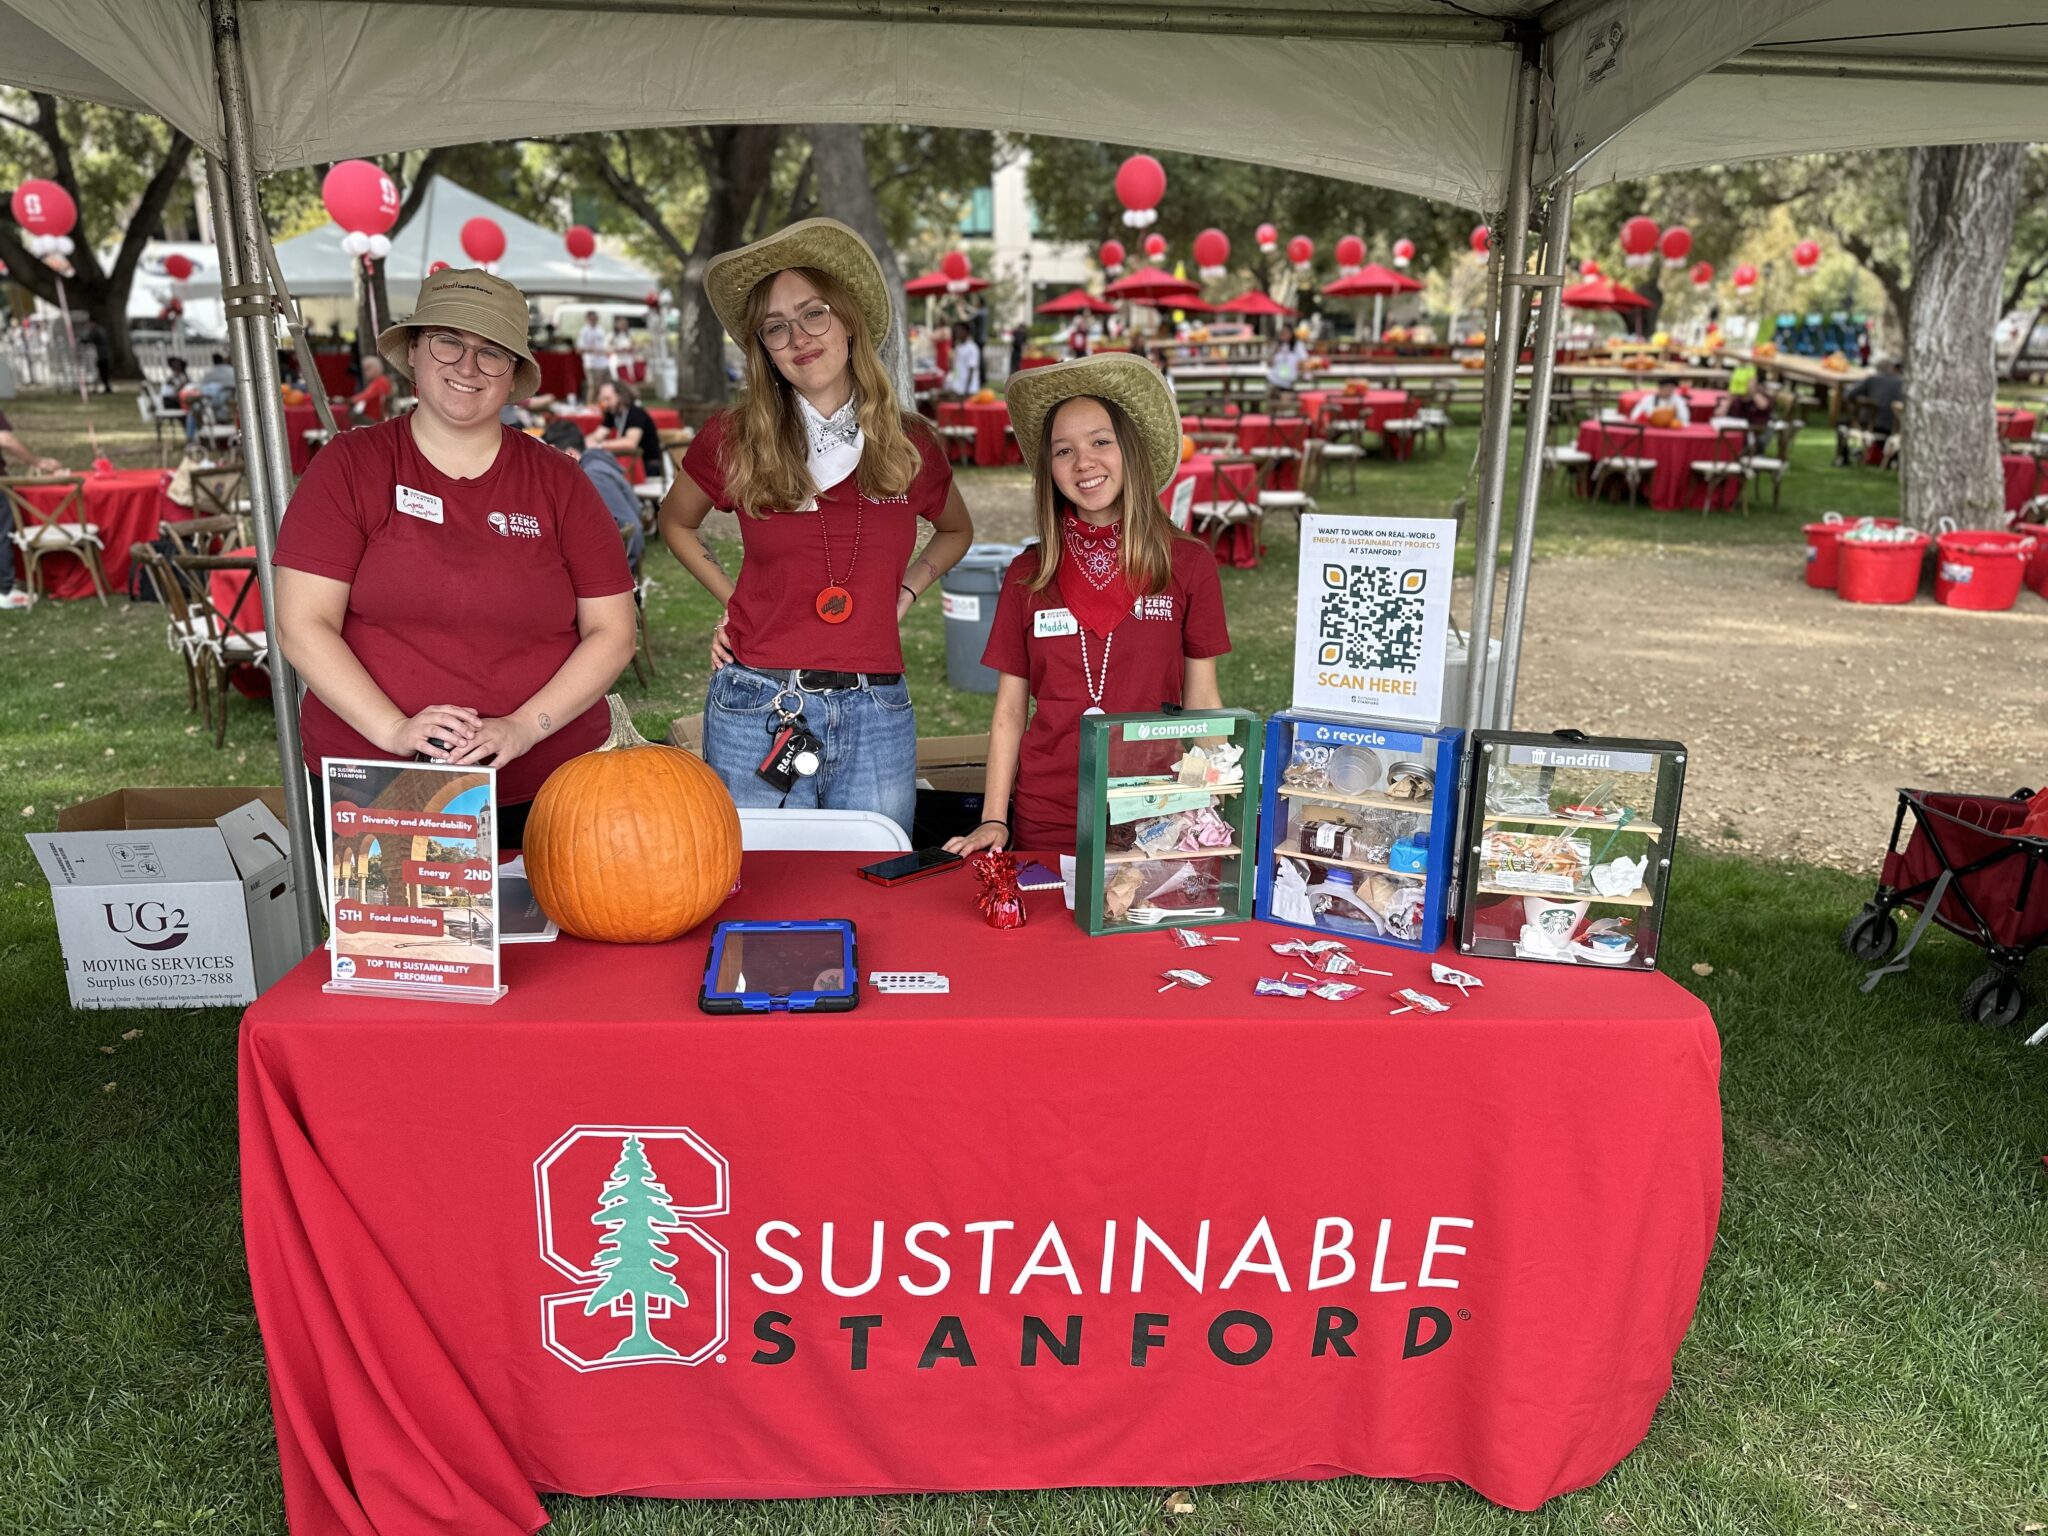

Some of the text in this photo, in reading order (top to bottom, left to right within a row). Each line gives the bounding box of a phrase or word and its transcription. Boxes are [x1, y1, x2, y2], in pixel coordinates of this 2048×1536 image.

[509, 516, 539, 529] ZERO
[510, 525, 541, 536] WASTE
[1318, 527, 1339, 536] WANT
[1341, 528, 1351, 536] TO
[1351, 529, 1375, 537] WORK
[1388, 531, 1436, 540] REAL-WORLD
[1312, 536, 1339, 544] ENERGY
[1348, 537, 1402, 547] SUSTAINABILITY
[1404, 541, 1440, 549] PROJECTS
[1360, 548, 1402, 556] STANFORD?
[1145, 600, 1173, 609] ZERO
[1145, 608, 1172, 617] WASTE
[1039, 621, 1070, 635] Maddy
[1317, 672, 1417, 696] SCAN HERE!
[1151, 722, 1208, 737] compost
[1333, 731, 1386, 746] recycle
[1550, 752, 1611, 768] landfill
[336, 811, 473, 832] 1ST Diversity and Affordability
[418, 868, 492, 881] Energy 2ND
[101, 902, 190, 933] UG2
[339, 909, 438, 927] 5TH Food and Dining
[82, 956, 234, 973] MOVING SERVICES
[366, 959, 469, 974] TOP TEN SUSTAINABILITY
[87, 973, 234, 991] Surplus (650)723-7888
[394, 971, 444, 983] PERFORMER
[751, 1216, 1475, 1298] SUSTAINABLE
